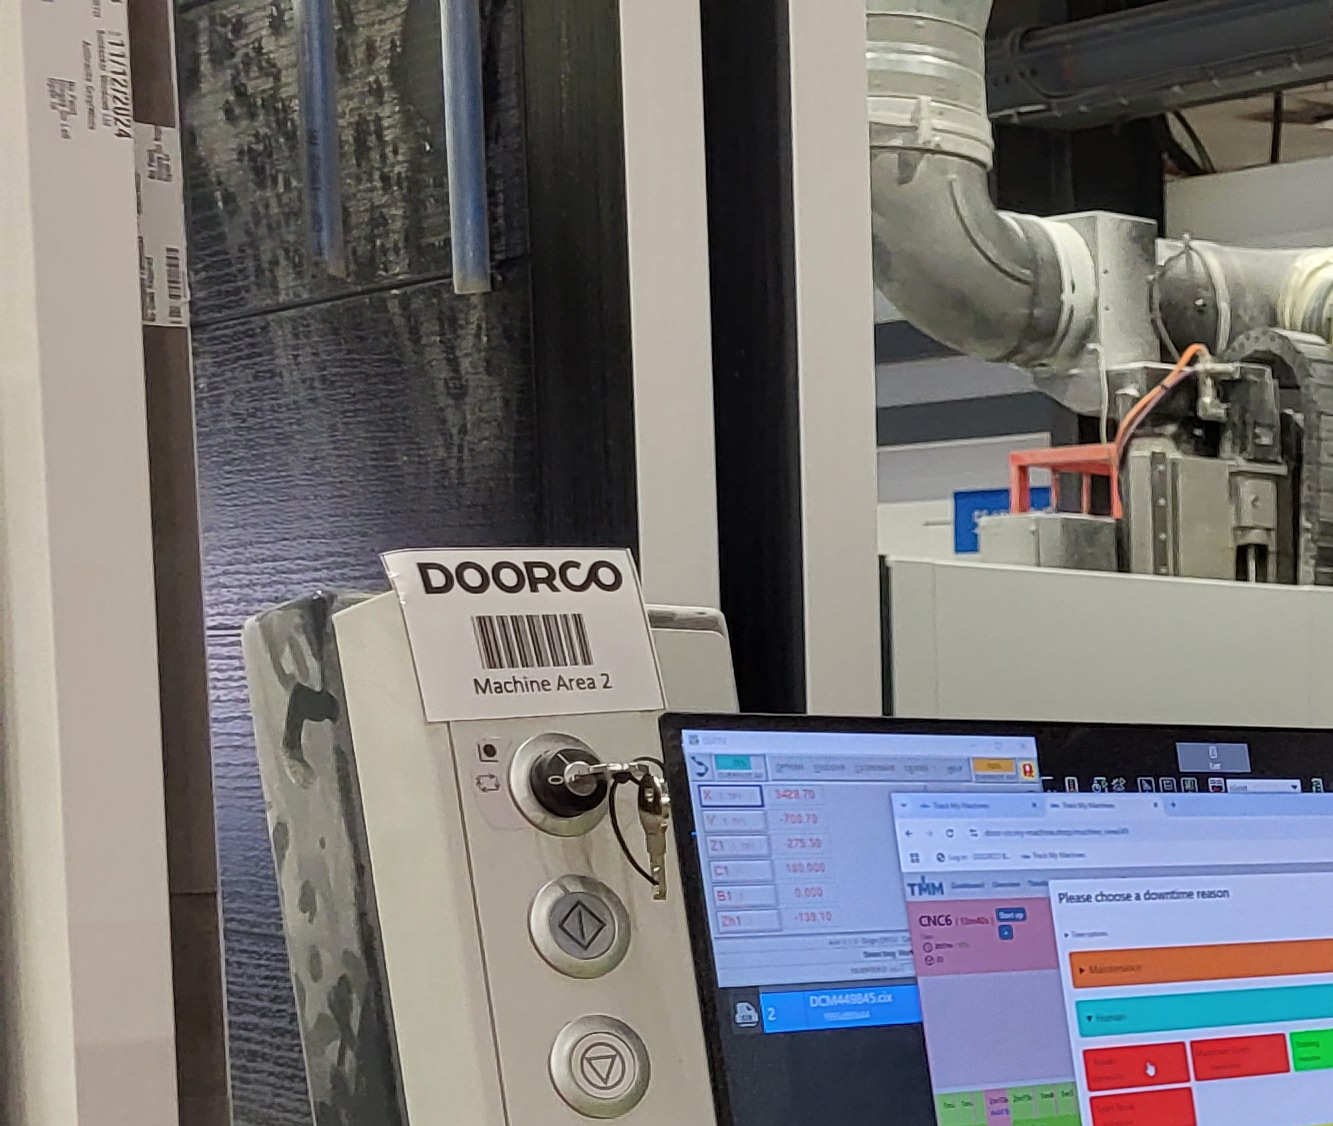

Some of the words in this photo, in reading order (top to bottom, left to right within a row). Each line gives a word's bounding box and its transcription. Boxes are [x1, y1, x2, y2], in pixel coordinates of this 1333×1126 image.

[108, 39, 132, 139] 11/12/2024
[417, 560, 624, 596] DOORCO
[474, 675, 552, 695] Machine
[556, 675, 596, 692] Area
[601, 674, 612, 689] 2
[703, 789, 712, 800] X
[710, 839, 725, 851] Z1
[714, 865, 729, 876] C1
[717, 890, 732, 902] B1
[794, 887, 823, 898] 0.000
[1058, 891, 1093, 904] Please
[1094, 889, 1132, 902] choose
[1135, 892, 1141, 901] a
[1143, 888, 1194, 900] downtime
[1196, 889, 1230, 899] reason
[918, 914, 952, 927] CNC6
[767, 1007, 776, 1021] 2
